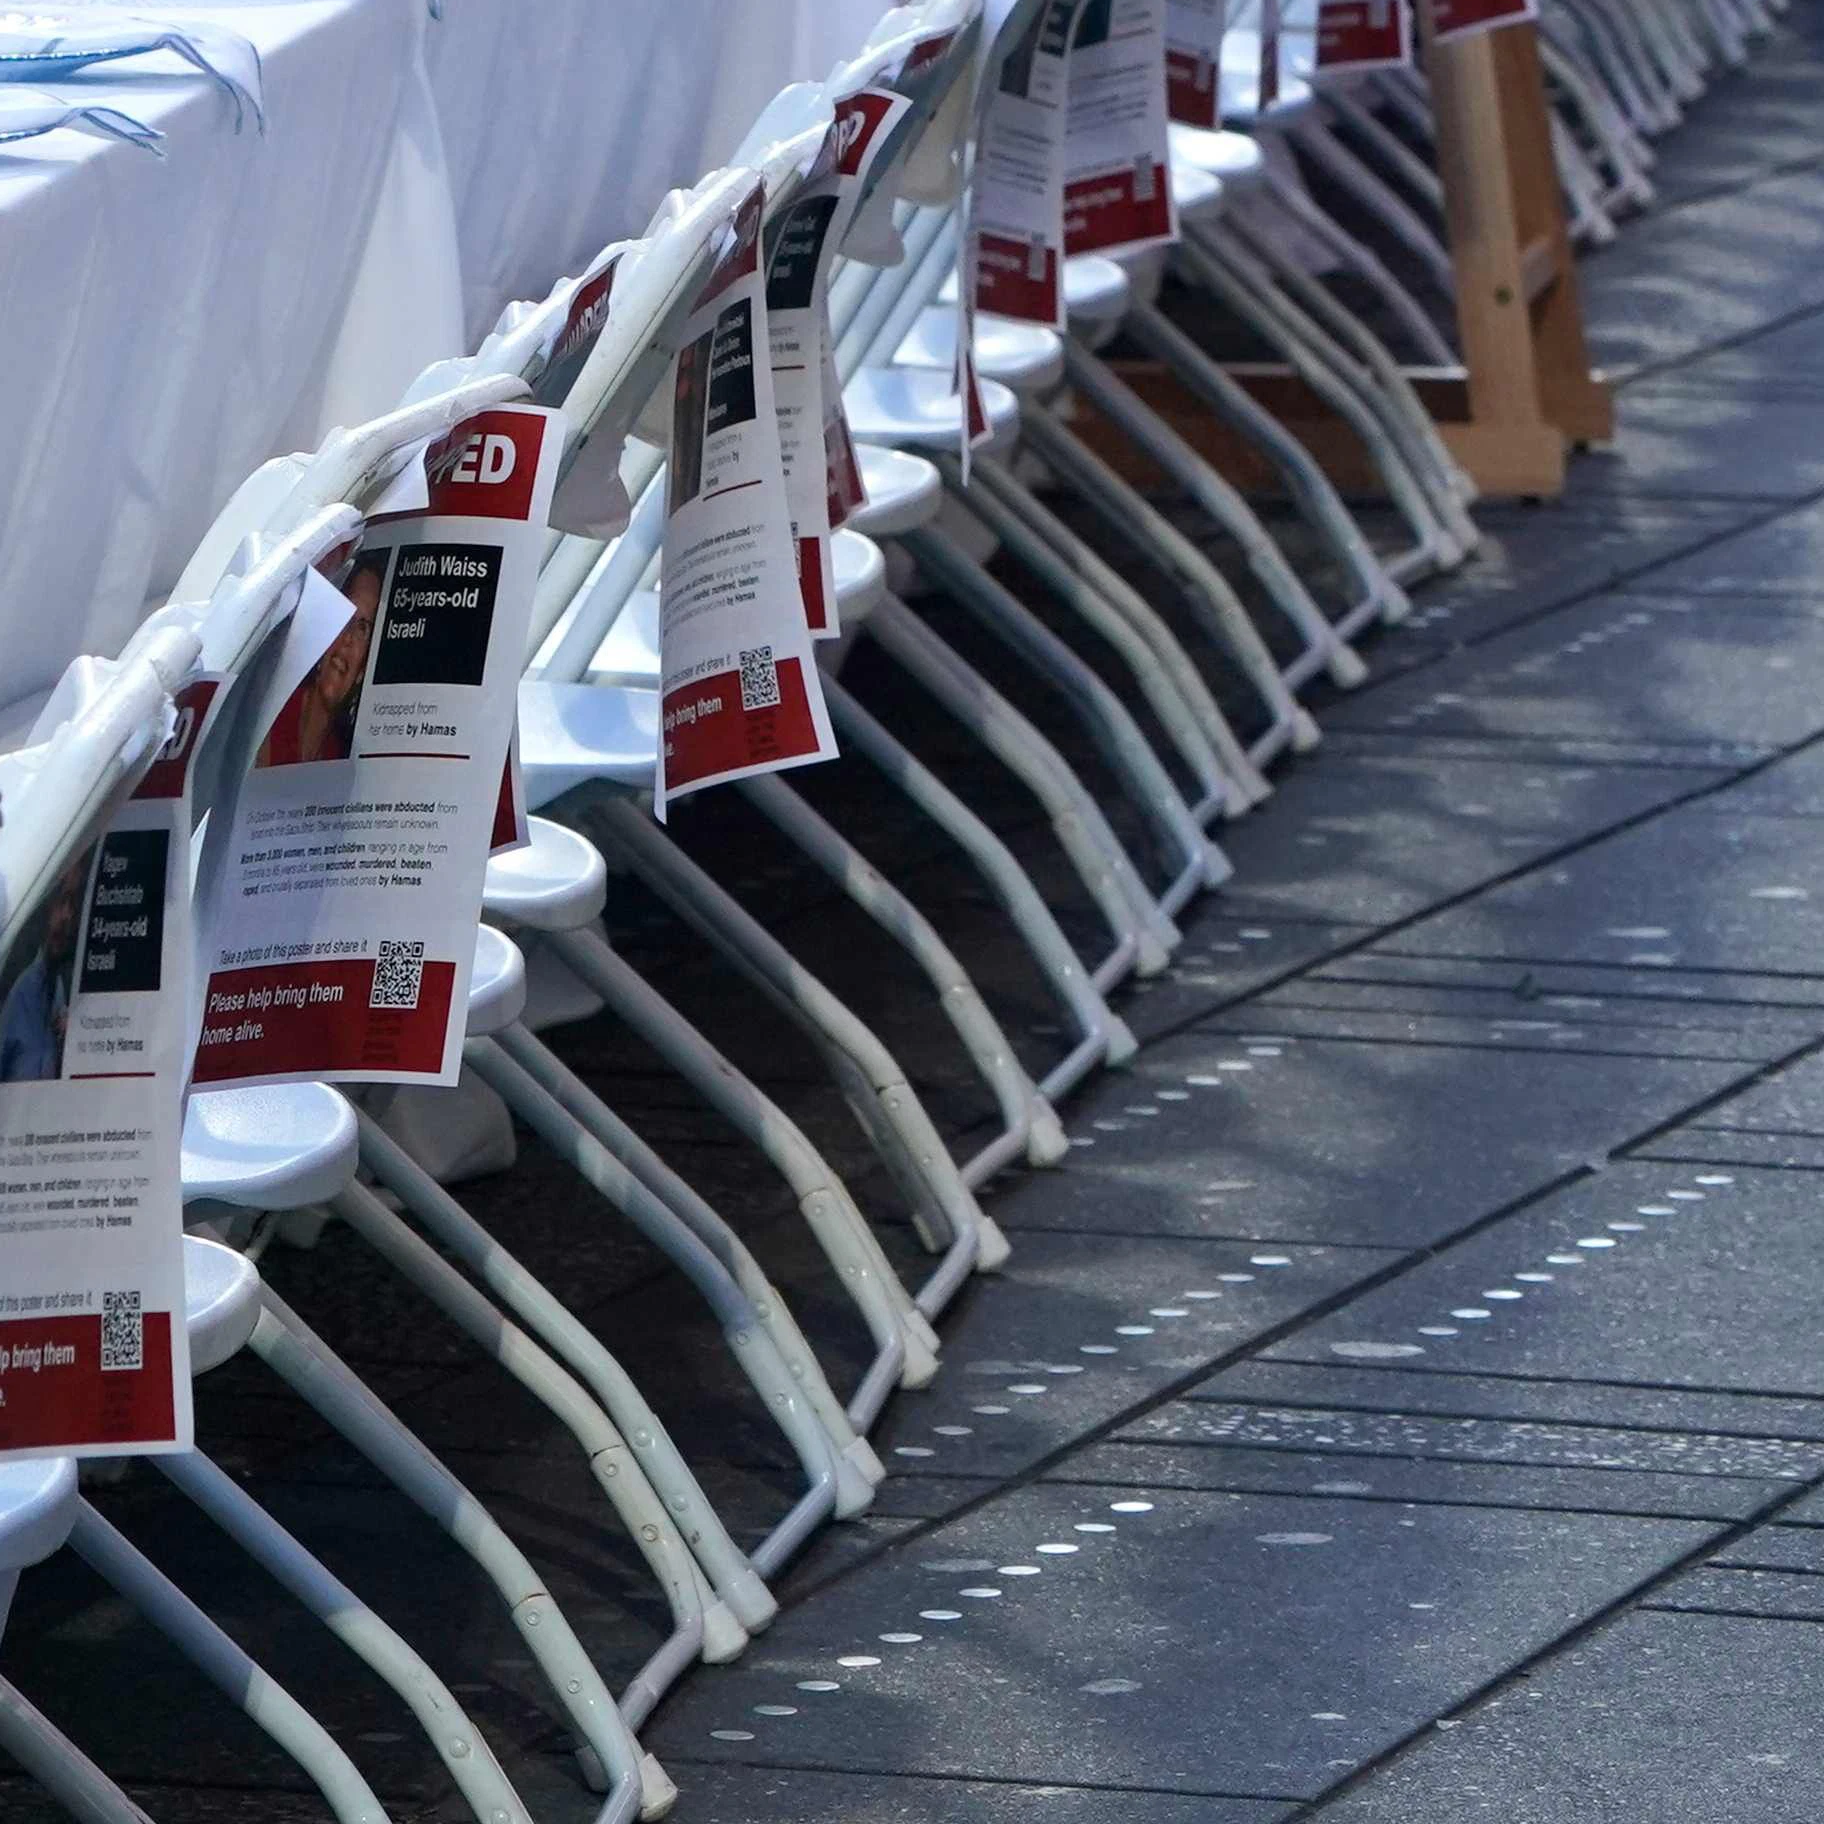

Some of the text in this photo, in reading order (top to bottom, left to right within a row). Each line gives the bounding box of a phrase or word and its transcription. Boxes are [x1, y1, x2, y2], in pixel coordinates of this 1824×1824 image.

[449, 432, 518, 485] ED
[398, 555, 488, 579] Judith Waiss
[393, 586, 479, 612] 65-years-old
[386, 617, 427, 640] Israeli
[406, 722, 418, 738] by
[420, 721, 457, 736] Hamas
[375, 802, 393, 814] were
[394, 801, 435, 814] abducted
[378, 875, 389, 888] by
[272, 942, 288, 958] this
[287, 942, 314, 960] poster
[314, 940, 332, 955] and
[332, 938, 359, 954] share
[208, 981, 344, 1014] Please help bring them
[201, 1019, 265, 1046] home alive.
[12, 1343, 42, 1372] bring
[43, 1341, 75, 1364] them
